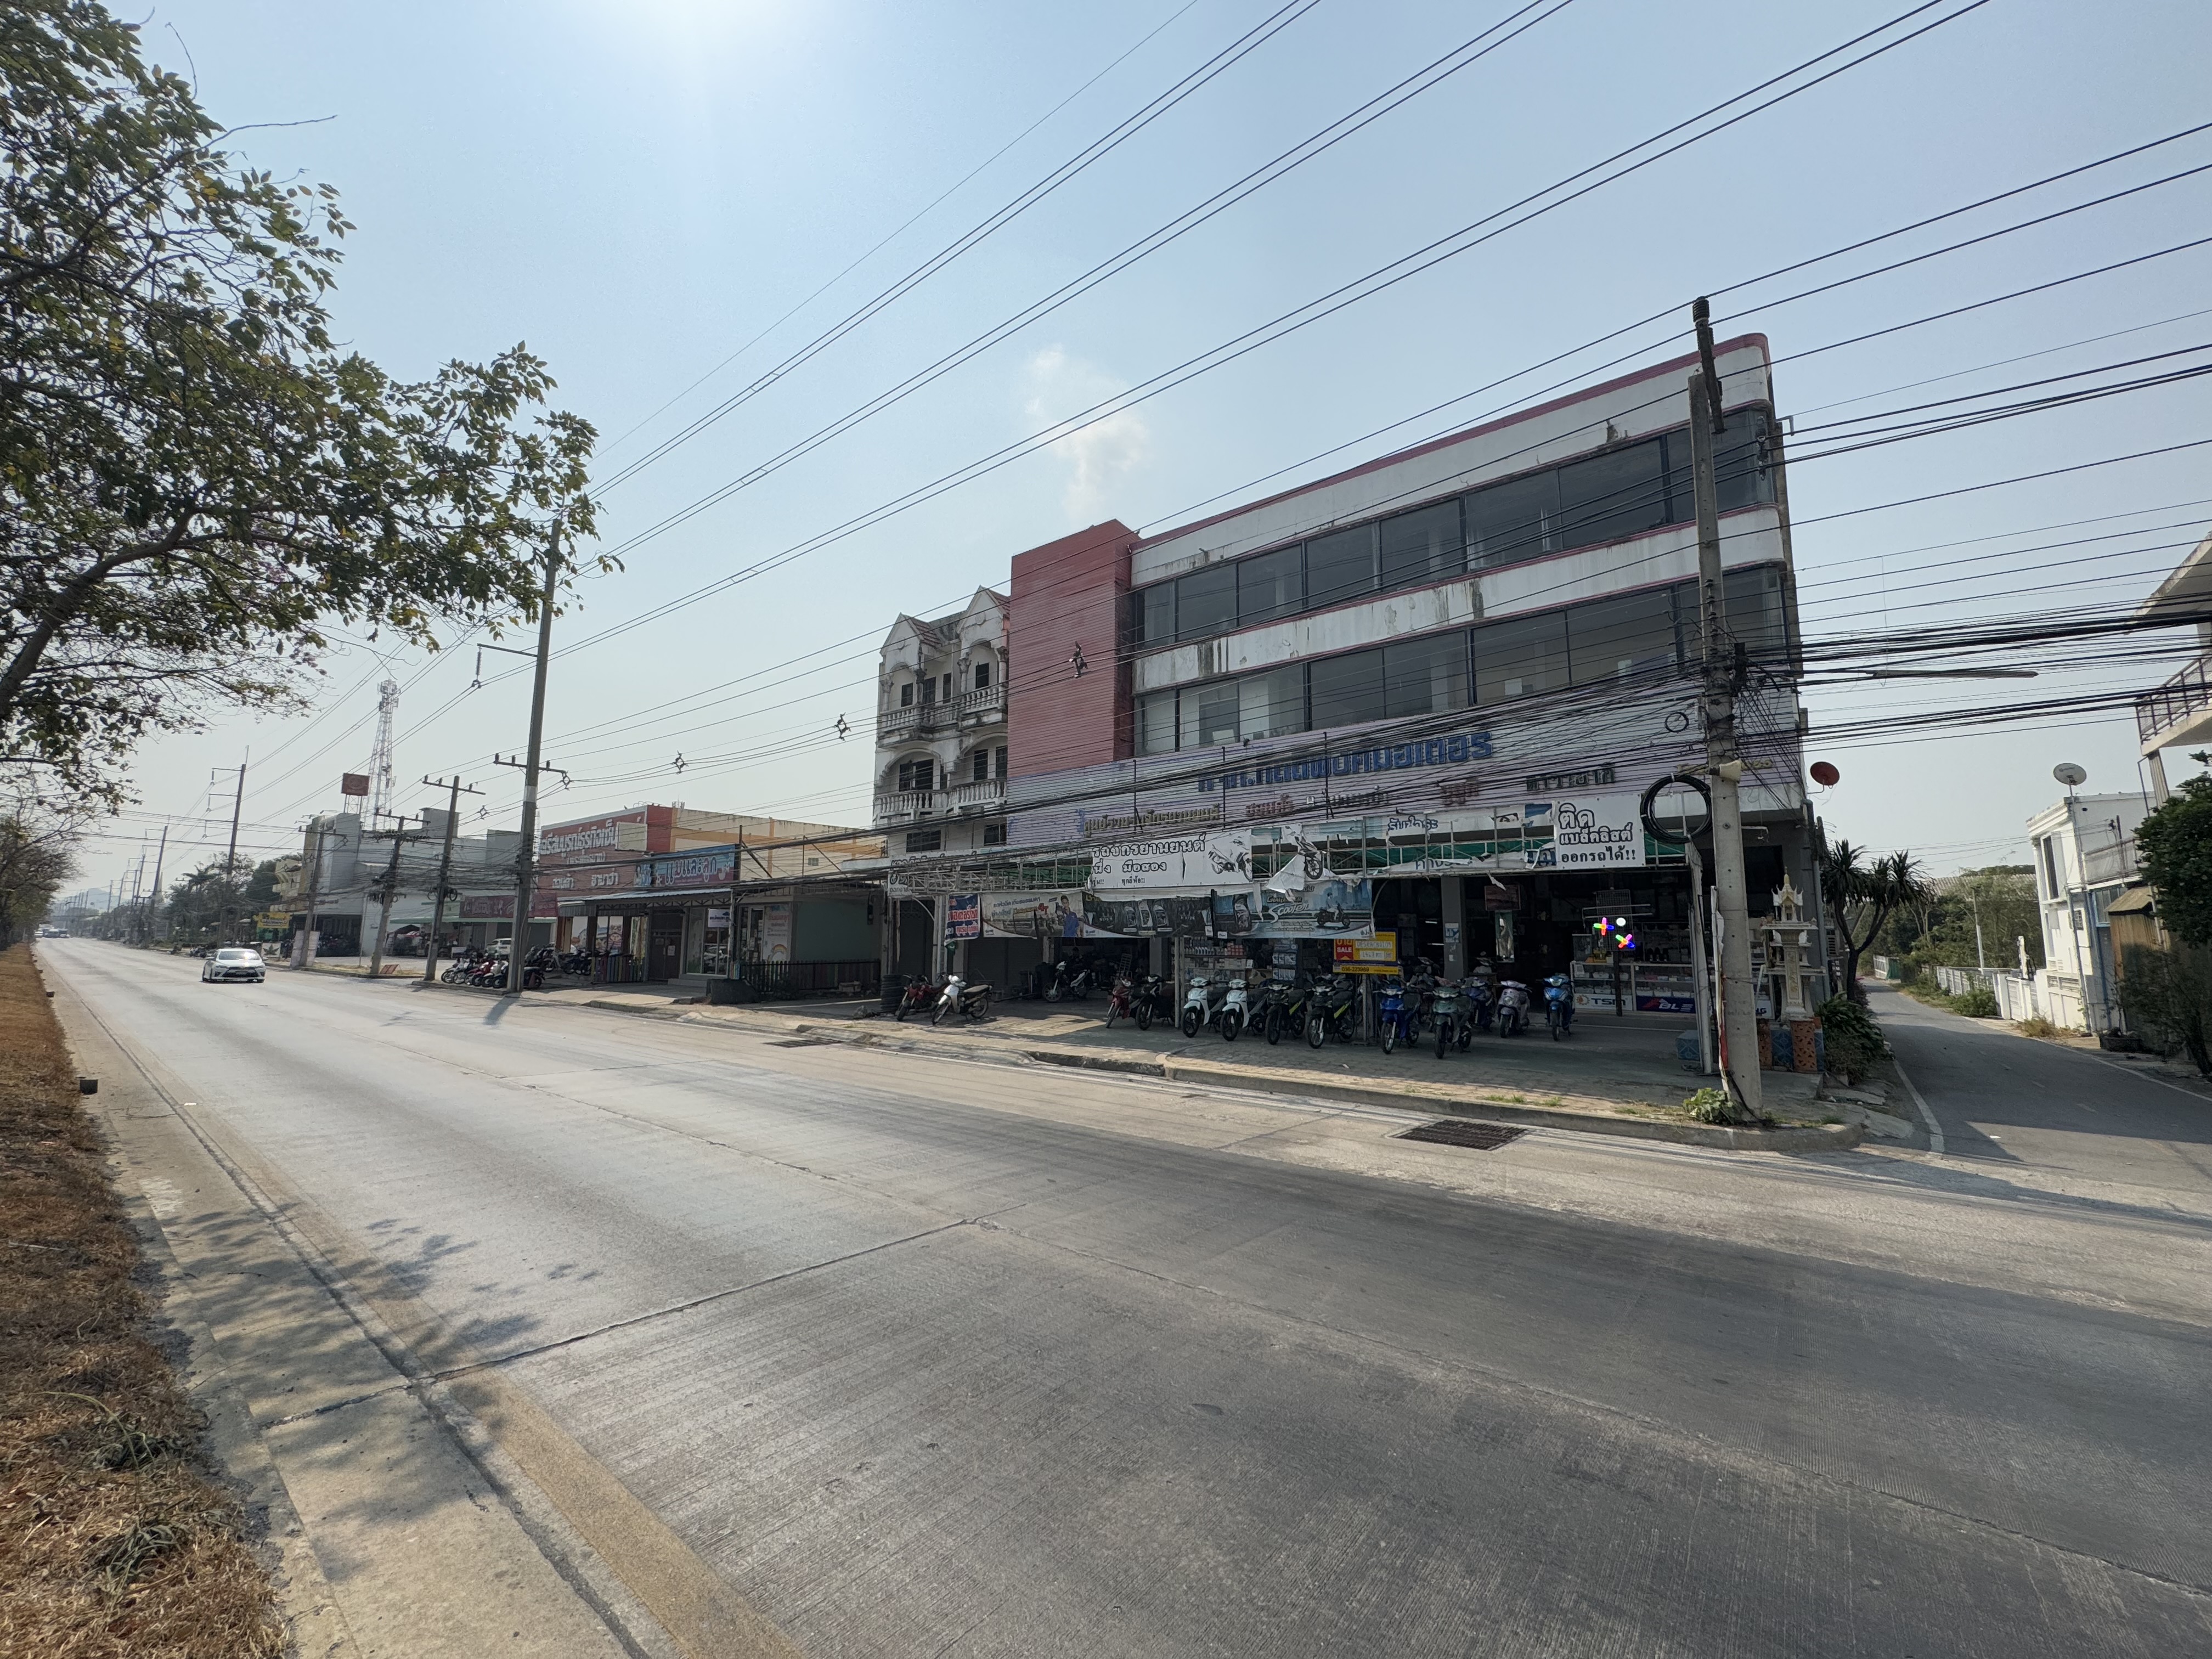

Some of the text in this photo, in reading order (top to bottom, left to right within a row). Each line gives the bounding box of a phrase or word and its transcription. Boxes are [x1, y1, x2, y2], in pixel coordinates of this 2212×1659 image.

[1558, 803, 1595, 830] ติด
[1559, 821, 1633, 845] แบล็คลิสต์
[1092, 834, 1206, 857] รถจกรยานยนต์
[1561, 845, 1636, 862] ออกรถได้!!
[665, 855, 718, 885] แมและลูก
[1122, 859, 1167, 873] มือสอง
